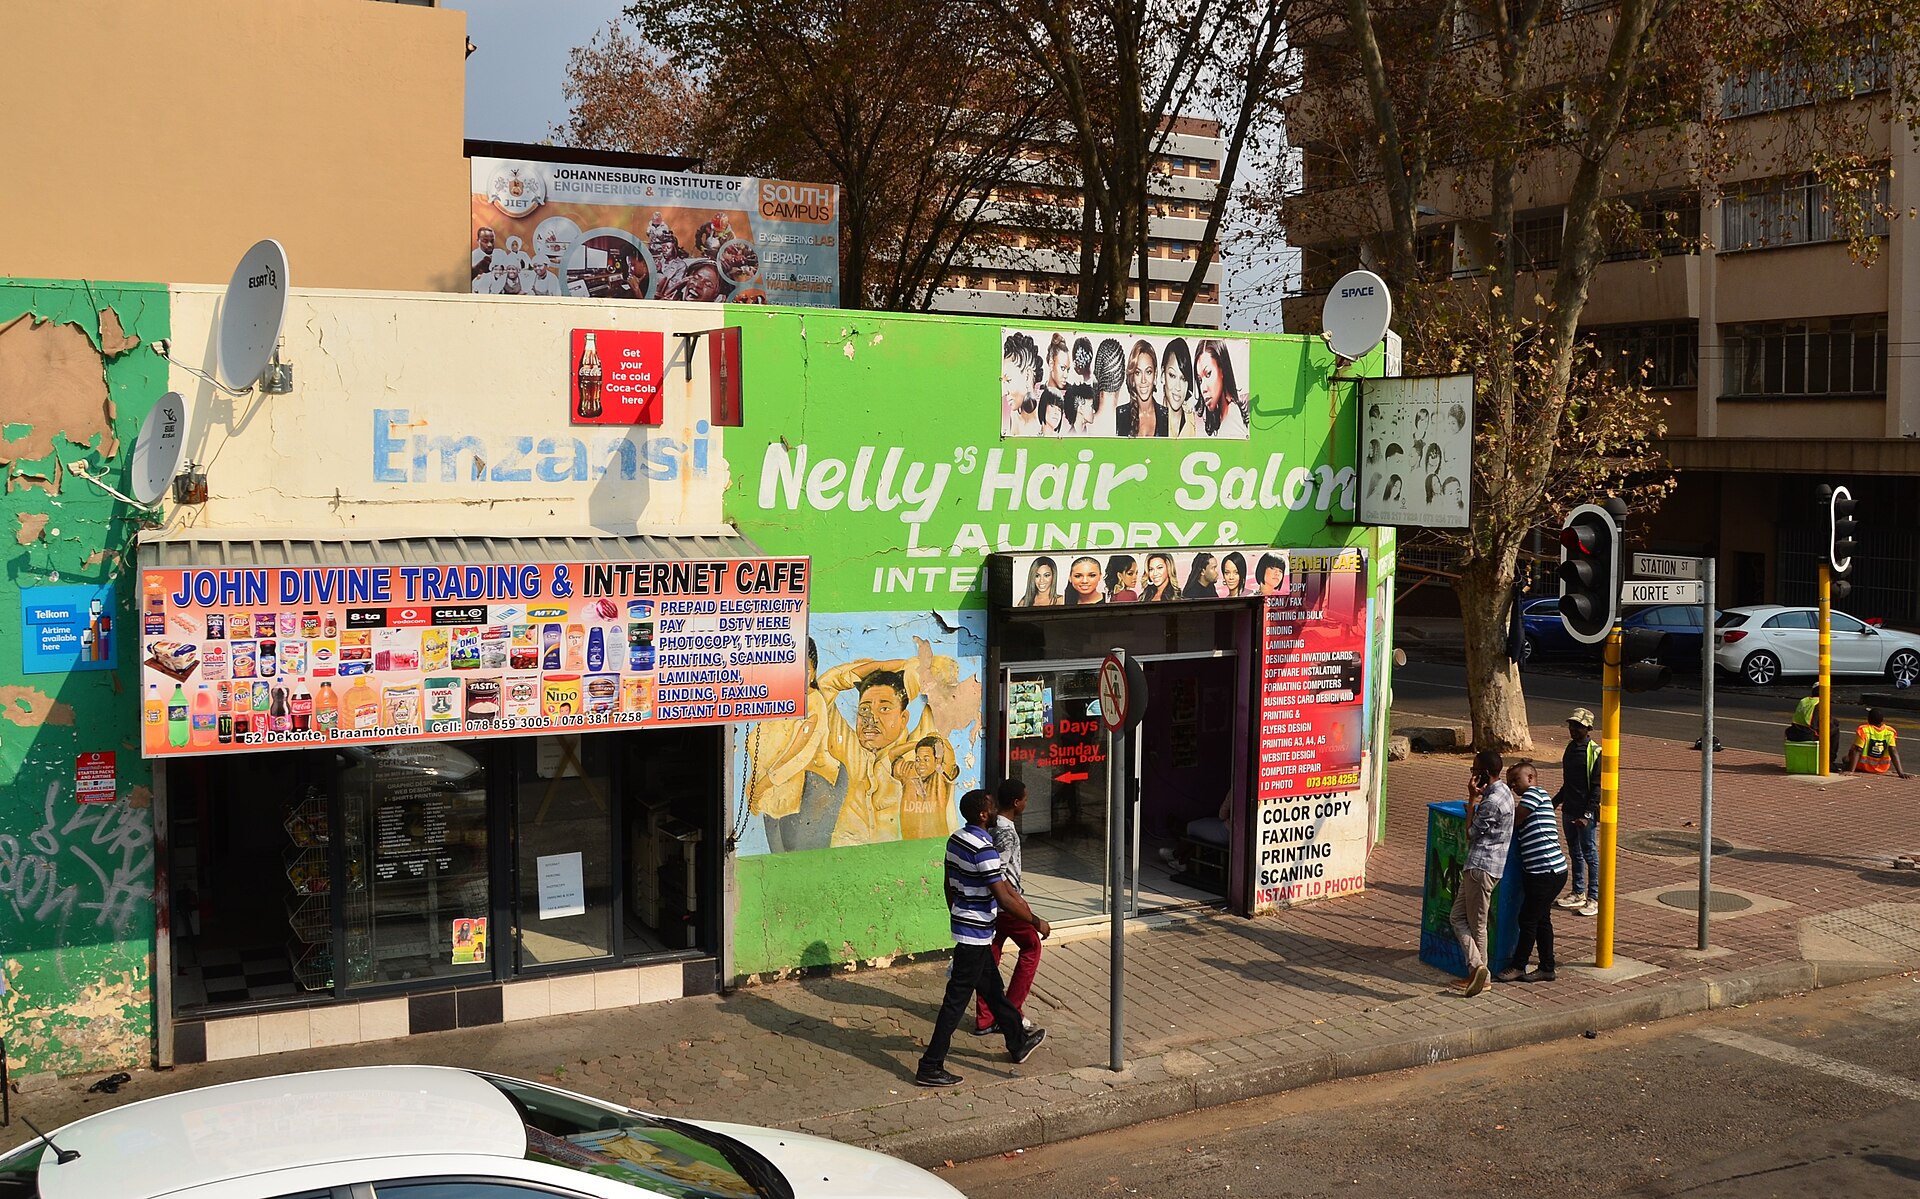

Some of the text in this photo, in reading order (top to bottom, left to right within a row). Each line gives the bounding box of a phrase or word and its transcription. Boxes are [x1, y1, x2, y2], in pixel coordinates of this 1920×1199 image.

[553, 168, 742, 191] JOHANNESBURG INSTITUTE OF
[554, 181, 741, 203] ENGINEERING & TECHNOLOGY
[762, 183, 829, 206] SOUTH
[504, 199, 529, 208] JIET
[762, 202, 830, 221] CAMPUS
[759, 232, 835, 247] ENGINEERING LAB
[762, 251, 808, 265] LIBRARY
[249, 274, 268, 288] ELSAT
[765, 271, 833, 284] HOTEL & CATERING
[767, 280, 833, 293] MANAGEMENT
[1341, 286, 1374, 298] SPACE
[622, 348, 641, 358] Get
[620, 361, 643, 371] your
[612, 371, 627, 381] ice
[629, 372, 651, 382] cold
[605, 383, 657, 394] Coca-Cola
[621, 395, 644, 405] here
[373, 407, 709, 483] Emzansi
[977, 445, 1148, 512] Hair
[1174, 451, 1356, 511] Salon
[905, 520, 1244, 558] LAUNDRY &
[1331, 554, 1361, 569] CAFE
[1640, 558, 1688, 575] STATION ST
[172, 561, 807, 607] JOHN DIVINE TRADING & INTERNET CAFE
[1632, 585, 1685, 600] KORTE ST
[660, 599, 803, 614] PREPAID ELECTRICITY
[1266, 597, 1284, 607] SCAN
[1289, 597, 1303, 606] FAX
[35, 610, 70, 619] Telkom
[534, 609, 561, 617] MTN
[1266, 610, 1324, 621] PRINTING IN BULK
[42, 626, 71, 634] Airtime
[659, 616, 791, 632] PAY DSTV HERE
[1265, 626, 1293, 636] BINDING
[42, 634, 77, 642] available
[460, 636, 477, 647] OMO
[658, 634, 797, 650] PHOTOCOPY, TYPING,
[1265, 639, 1305, 650] LAMINATING
[42, 642, 60, 651] here
[204, 654, 224, 662] Selati
[658, 650, 796, 668] PRINTING, SCANNING
[1265, 653, 1300, 664] DESIGNING
[1332, 651, 1353, 661] CARDS
[658, 669, 743, 685] LAMINATION,
[1264, 665, 1341, 678] SOFTWARE INSTALATION
[469, 682, 499, 690] TASTIC
[1264, 679, 1342, 692] FORMATING COMPUTERS
[546, 691, 578, 702] NIDO
[657, 687, 718, 703] BINDING,
[720, 684, 768, 700] FAXING
[1263, 691, 1354, 707] BUSINESS CARD DESIGN AND
[657, 701, 796, 720] INSTANT ID PRINTING
[1263, 710, 1301, 721] PRINTING &
[245, 711, 643, 744] 52 Dekorte, Braamfontein Cell: 078 859 3005 078 381 7258
[1059, 720, 1099, 736] Days
[1262, 722, 1312, 735] FLYERS DESIGN
[1262, 738, 1293, 749] PRINTING
[1317, 735, 1326, 744] A5
[1049, 742, 1099, 760] Sunday
[1080, 753, 1106, 763] Door
[1262, 750, 1315, 763] WEBSITE DESIGN
[1261, 763, 1321, 777] COMPUTER REPAIR
[1271, 779, 1293, 790] PHOTO
[1306, 776, 1321, 788] 073
[1322, 775, 1337, 787] 438
[1338, 773, 1359, 785] 4255
[1263, 801, 1351, 825] COLOR COPY
[1262, 825, 1314, 845] FAXING
[1261, 843, 1331, 866] PRINTING
[1260, 863, 1324, 886] SCANING
[1325, 875, 1363, 894] PHOTO
